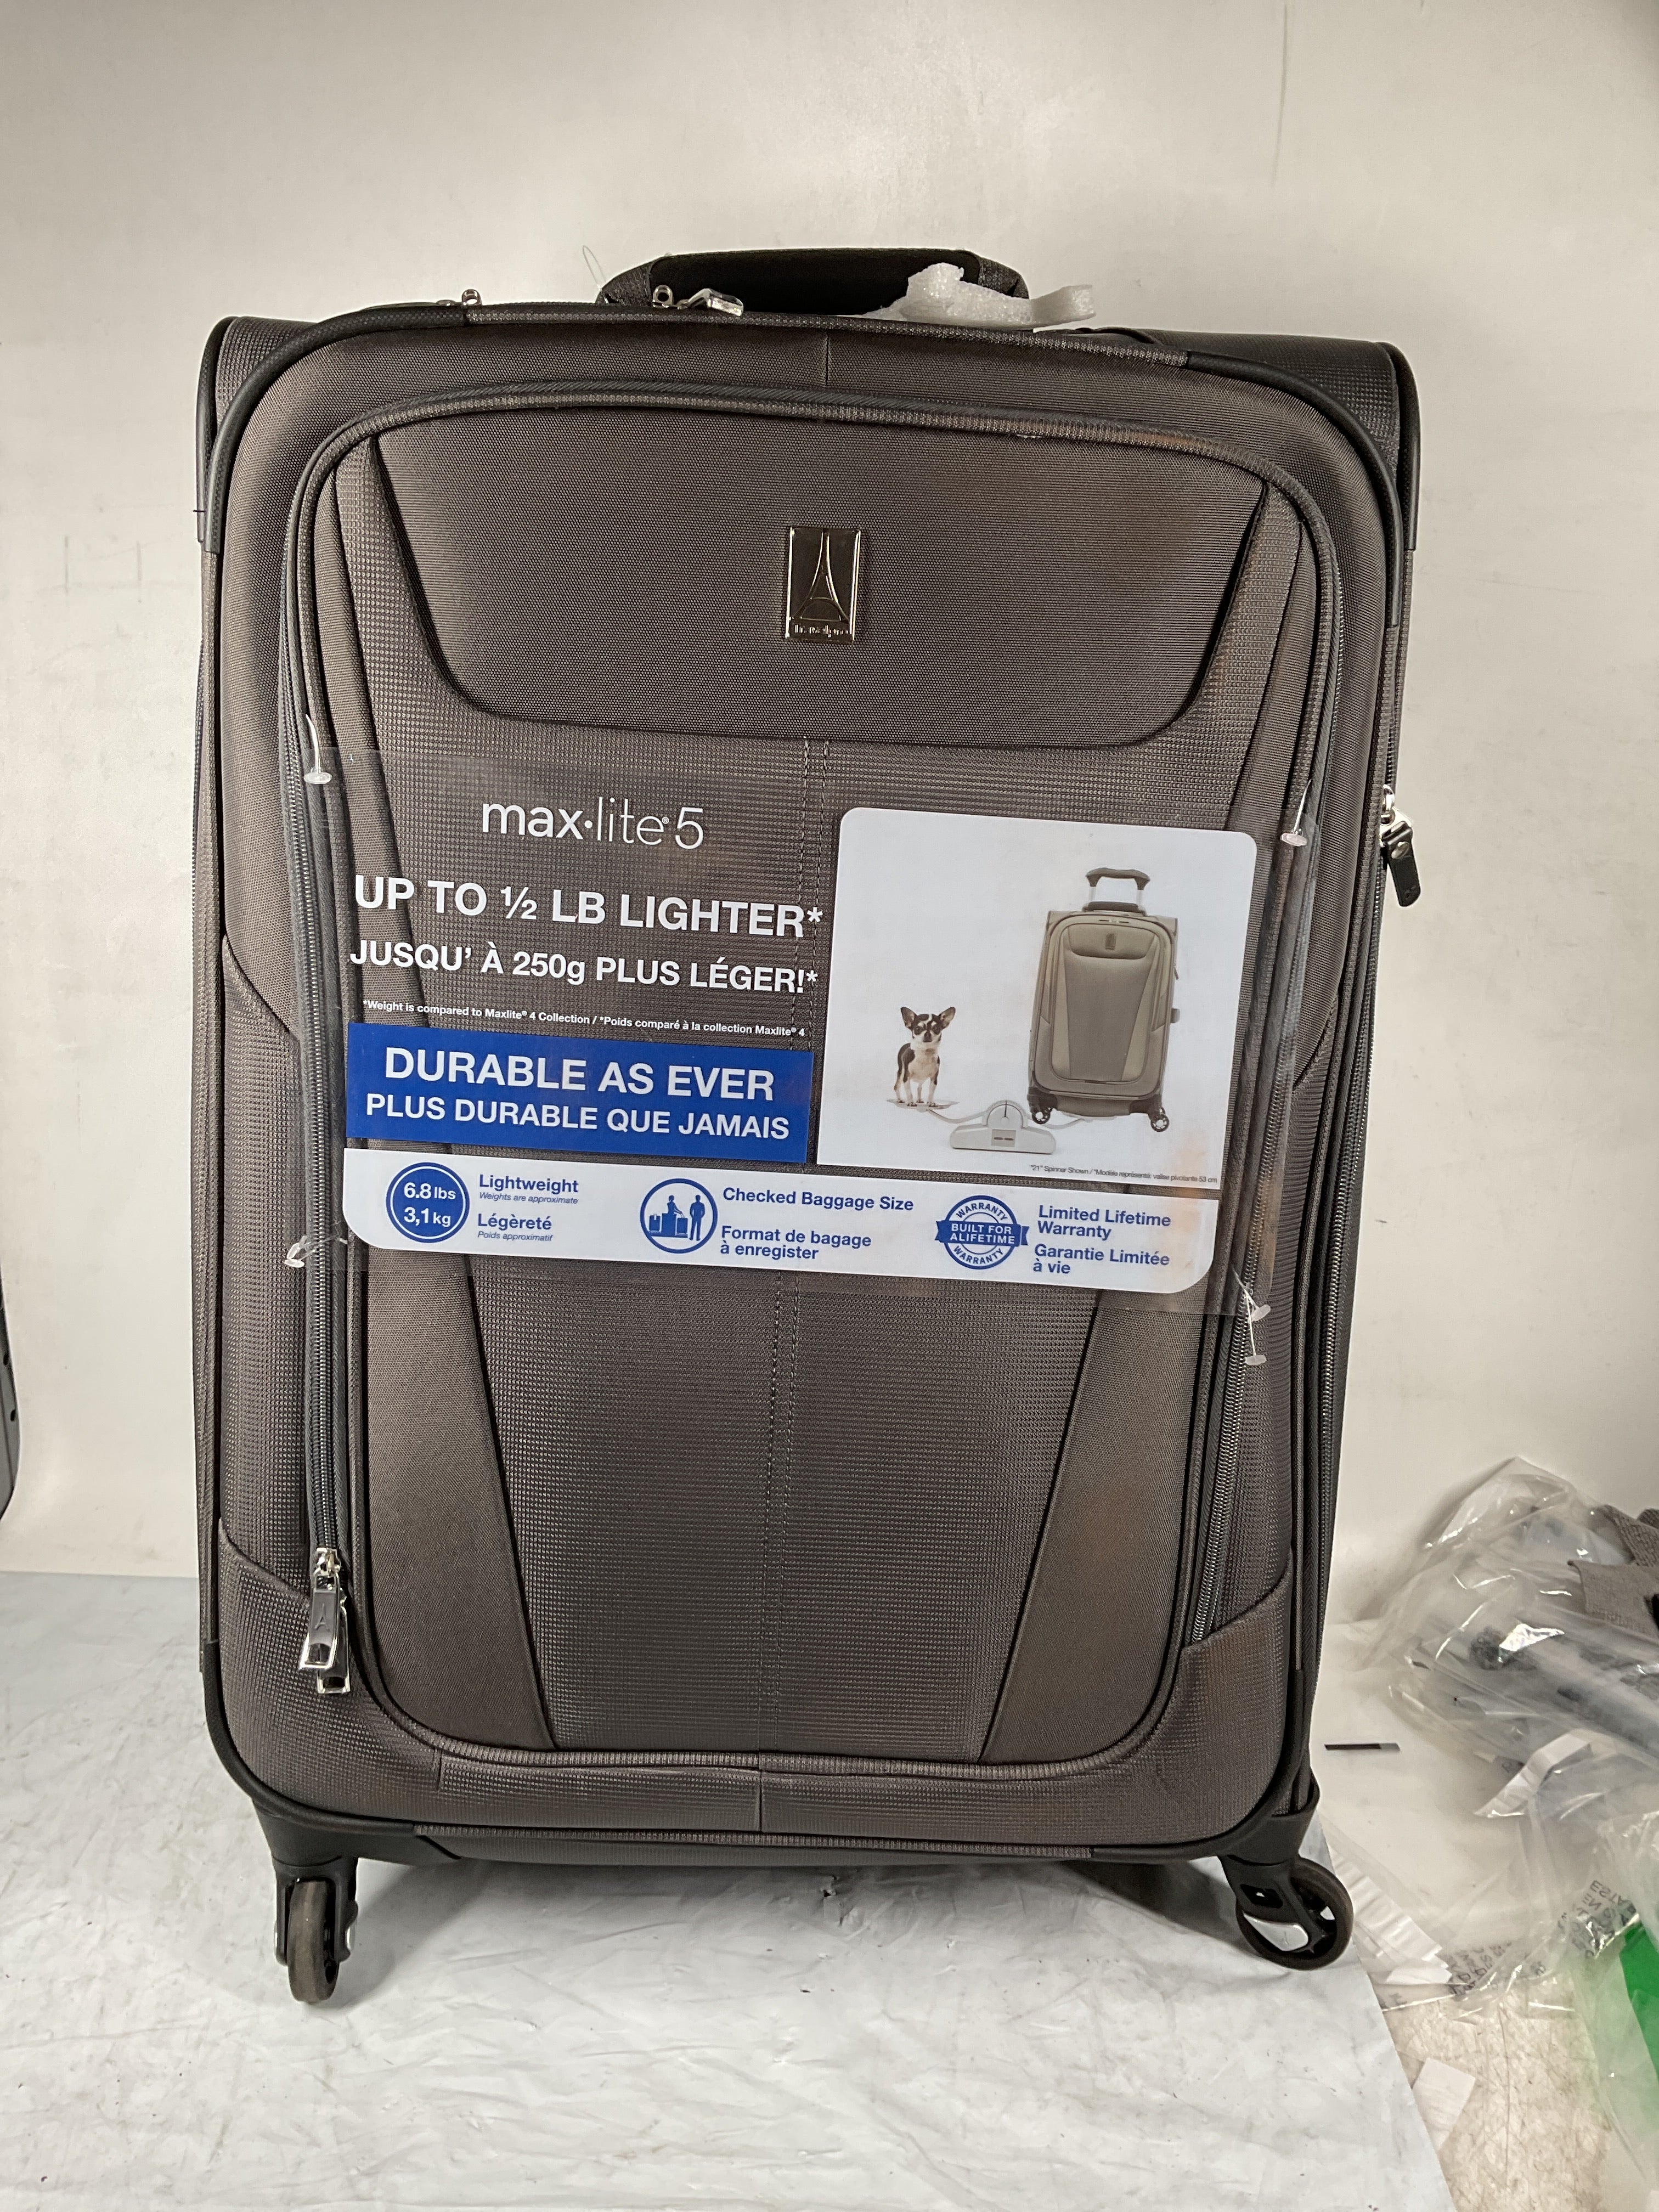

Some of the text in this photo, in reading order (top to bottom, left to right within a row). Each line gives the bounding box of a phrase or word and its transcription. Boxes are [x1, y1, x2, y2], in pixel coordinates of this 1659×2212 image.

[675, 807, 704, 850] 5
[354, 874, 415, 910] UP
[427, 879, 488, 916] TO
[552, 889, 606, 925] LB
[481, 941, 504, 974] À
[512, 951, 586, 985] 250g
[596, 956, 681, 986] PLUS
[405, 1002, 415, 1012] is
[417, 1004, 470, 1017] compared
[471, 1008, 482, 1017] to
[529, 1012, 536, 1020] 4
[538, 1013, 590, 1024] Collection
[592, 1015, 597, 1024] /
[635, 1019, 680, 1030] comparé
[682, 1020, 689, 1030] à
[691, 1022, 701, 1031] la
[703, 1023, 753, 1034] collection
[798, 1028, 805, 1037] 4
[385, 1047, 775, 1101] DURABLE AS EVER
[366, 1092, 789, 1140] PLUS DURABLE QUE JAMAIS
[403, 1181, 456, 1200] 6.8 lbs
[479, 1174, 579, 1195] Lightweight
[479, 1192, 512, 1202] Weights
[528, 1196, 578, 1205] approximate
[723, 1187, 914, 1211] Checked Baggage Size
[404, 1206, 452, 1228] 3,1 kg
[956, 1201, 1008, 1221] WARRANTY
[1039, 1204, 1171, 1227] Limited Lifetime
[477, 1212, 552, 1232] Légèreté
[951, 1222, 1012, 1234] BUILT FOR
[1037, 1220, 1112, 1241] Warranty
[477, 1231, 554, 1243] Poids approximatif
[721, 1225, 872, 1250] Format de bagage
[720, 1240, 819, 1260] à enregister
[953, 1245, 1003, 1265] WARRANTY
[1034, 1243, 1170, 1266] Garantie Limitée
[1032, 1257, 1071, 1274] à vie
